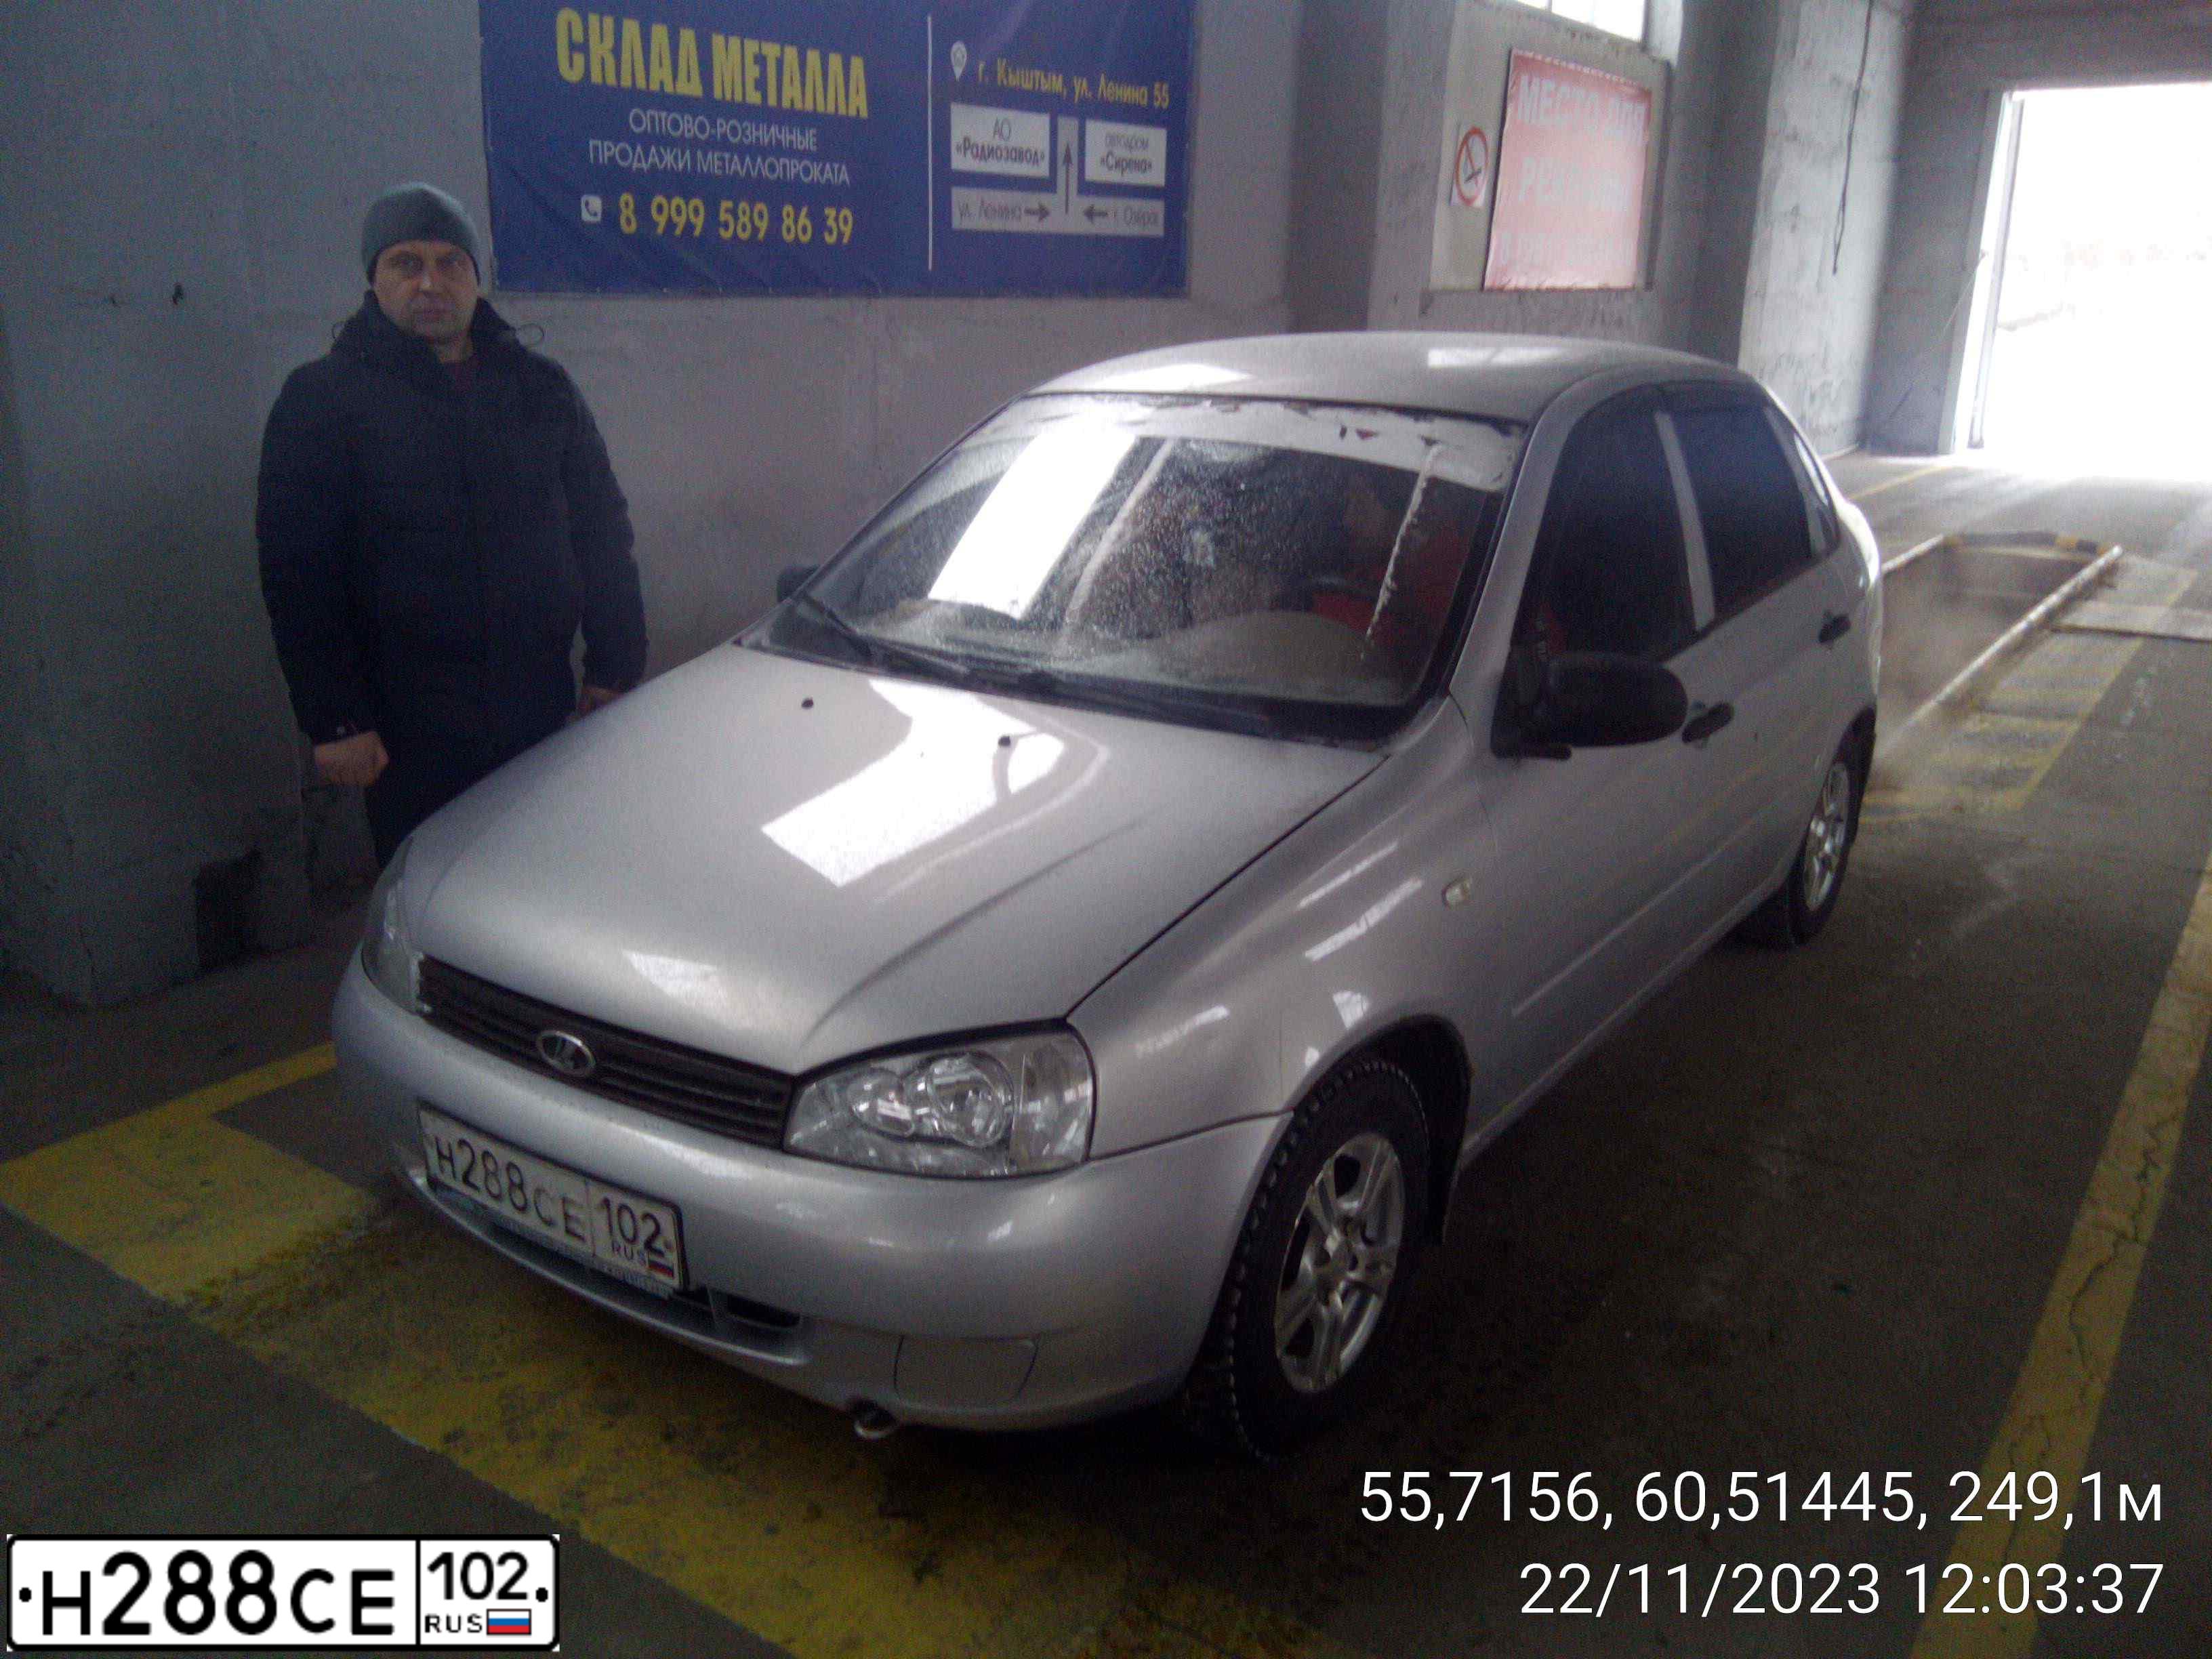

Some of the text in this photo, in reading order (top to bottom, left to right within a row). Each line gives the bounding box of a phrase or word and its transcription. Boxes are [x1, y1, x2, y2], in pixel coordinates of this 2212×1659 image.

[556, 7, 868, 119] СКЛАД МЕТАЛЛА
[997, 58, 1067, 99] Кыштым,
[1097, 73, 1148, 107] Ленина
[1153, 81, 1169, 110] 55
[629, 108, 817, 152] ОПТОВО-РОЗНИЧНЫЕ
[993, 116, 1012, 142] АО
[590, 139, 851, 186] ПРОДАЖИ МЕТАЛЛОПРОКАТА
[619, 192, 854, 245] 8 999 589 86 39
[600, 1196, 665, 1258] 102
